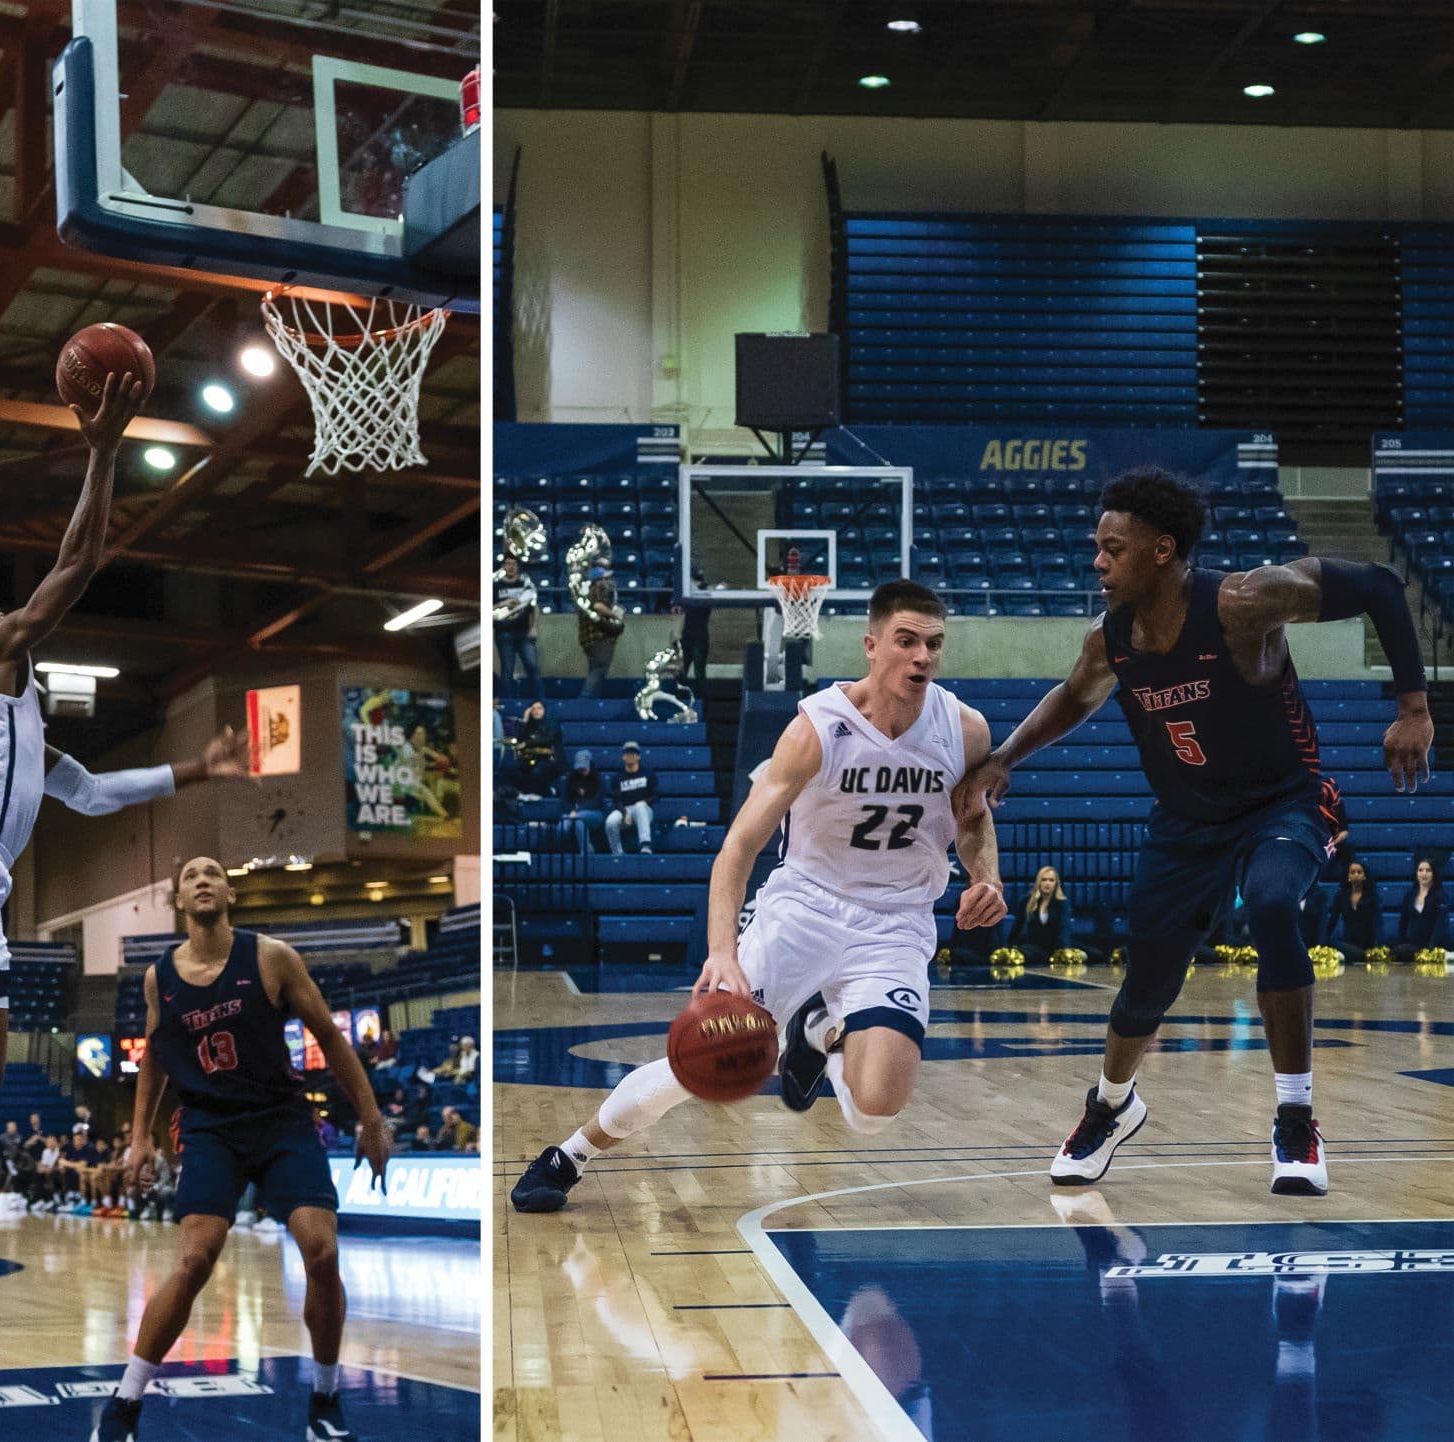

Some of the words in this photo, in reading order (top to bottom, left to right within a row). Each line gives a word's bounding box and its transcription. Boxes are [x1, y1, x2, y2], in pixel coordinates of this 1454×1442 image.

[1253, 434, 1273, 443] 204
[1381, 439, 1402, 449] 205
[980, 439, 1087, 470] AGGIES
[1131, 679, 1211, 712] TITANS
[350, 722, 406, 745] THIS
[1166, 721, 1207, 766] 5
[354, 744, 378, 764] IS
[354, 764, 413, 785] WHO
[840, 767, 871, 793] UC
[874, 766, 945, 793] DAVIS
[355, 783, 394, 804] WE
[356, 804, 412, 826] ARE.
[849, 804, 925, 851] 22
[197, 1031, 238, 1074] 13
